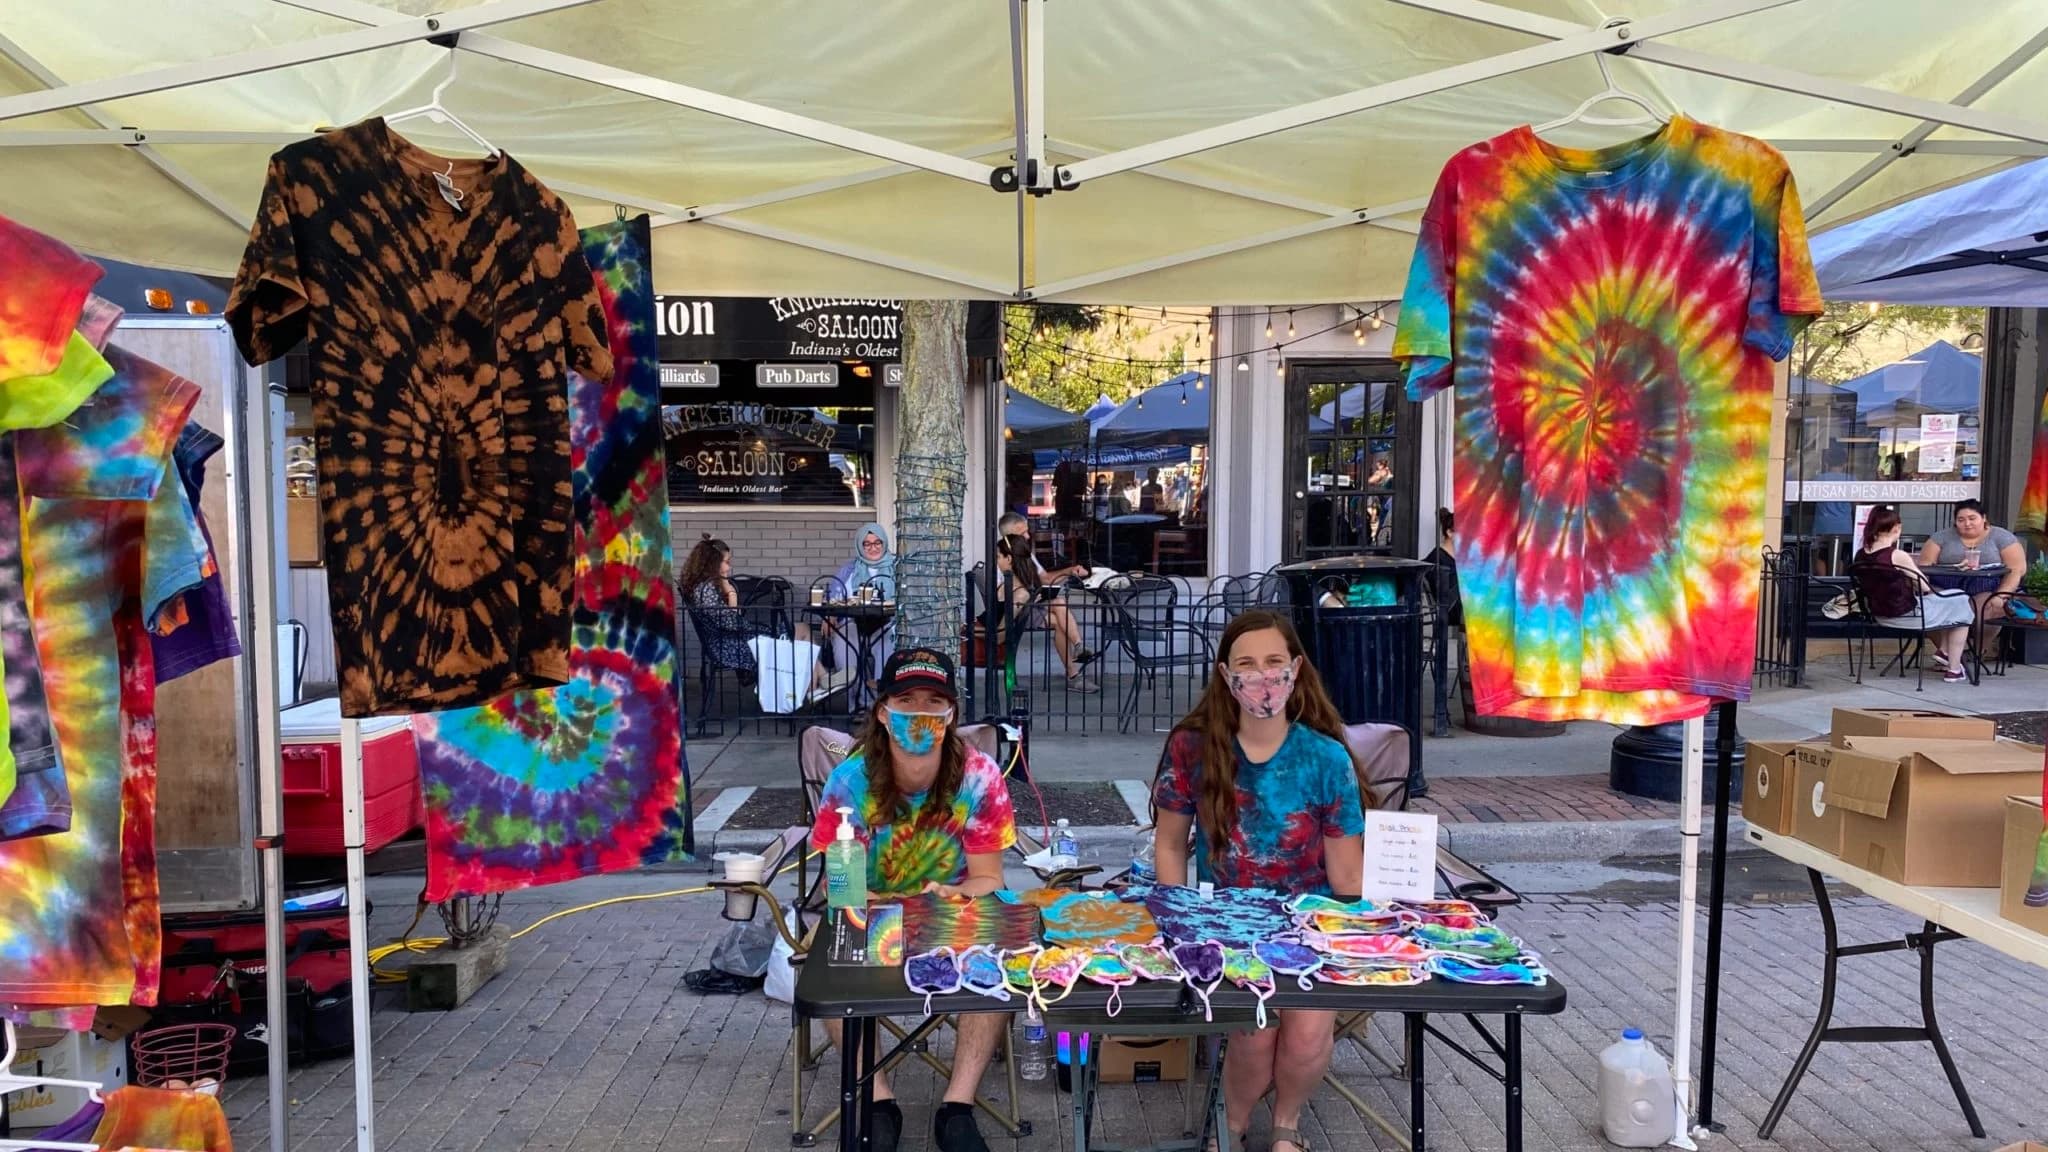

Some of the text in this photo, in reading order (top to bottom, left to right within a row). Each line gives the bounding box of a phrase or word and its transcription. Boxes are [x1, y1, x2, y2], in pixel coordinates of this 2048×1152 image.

[655, 295, 715, 336] ion
[817, 314, 898, 339] SALOON
[789, 341, 900, 358] Indiana's Oldest
[660, 368, 706, 384] illiards
[765, 368, 831, 384] Pub Darts
[661, 400, 836, 451] NICKERBOCKER
[697, 450, 786, 476] SALOON
[742, 484, 767, 493] Oldest
[1795, 484, 1968, 498] ARTISAN PIES AND PASTRIES
